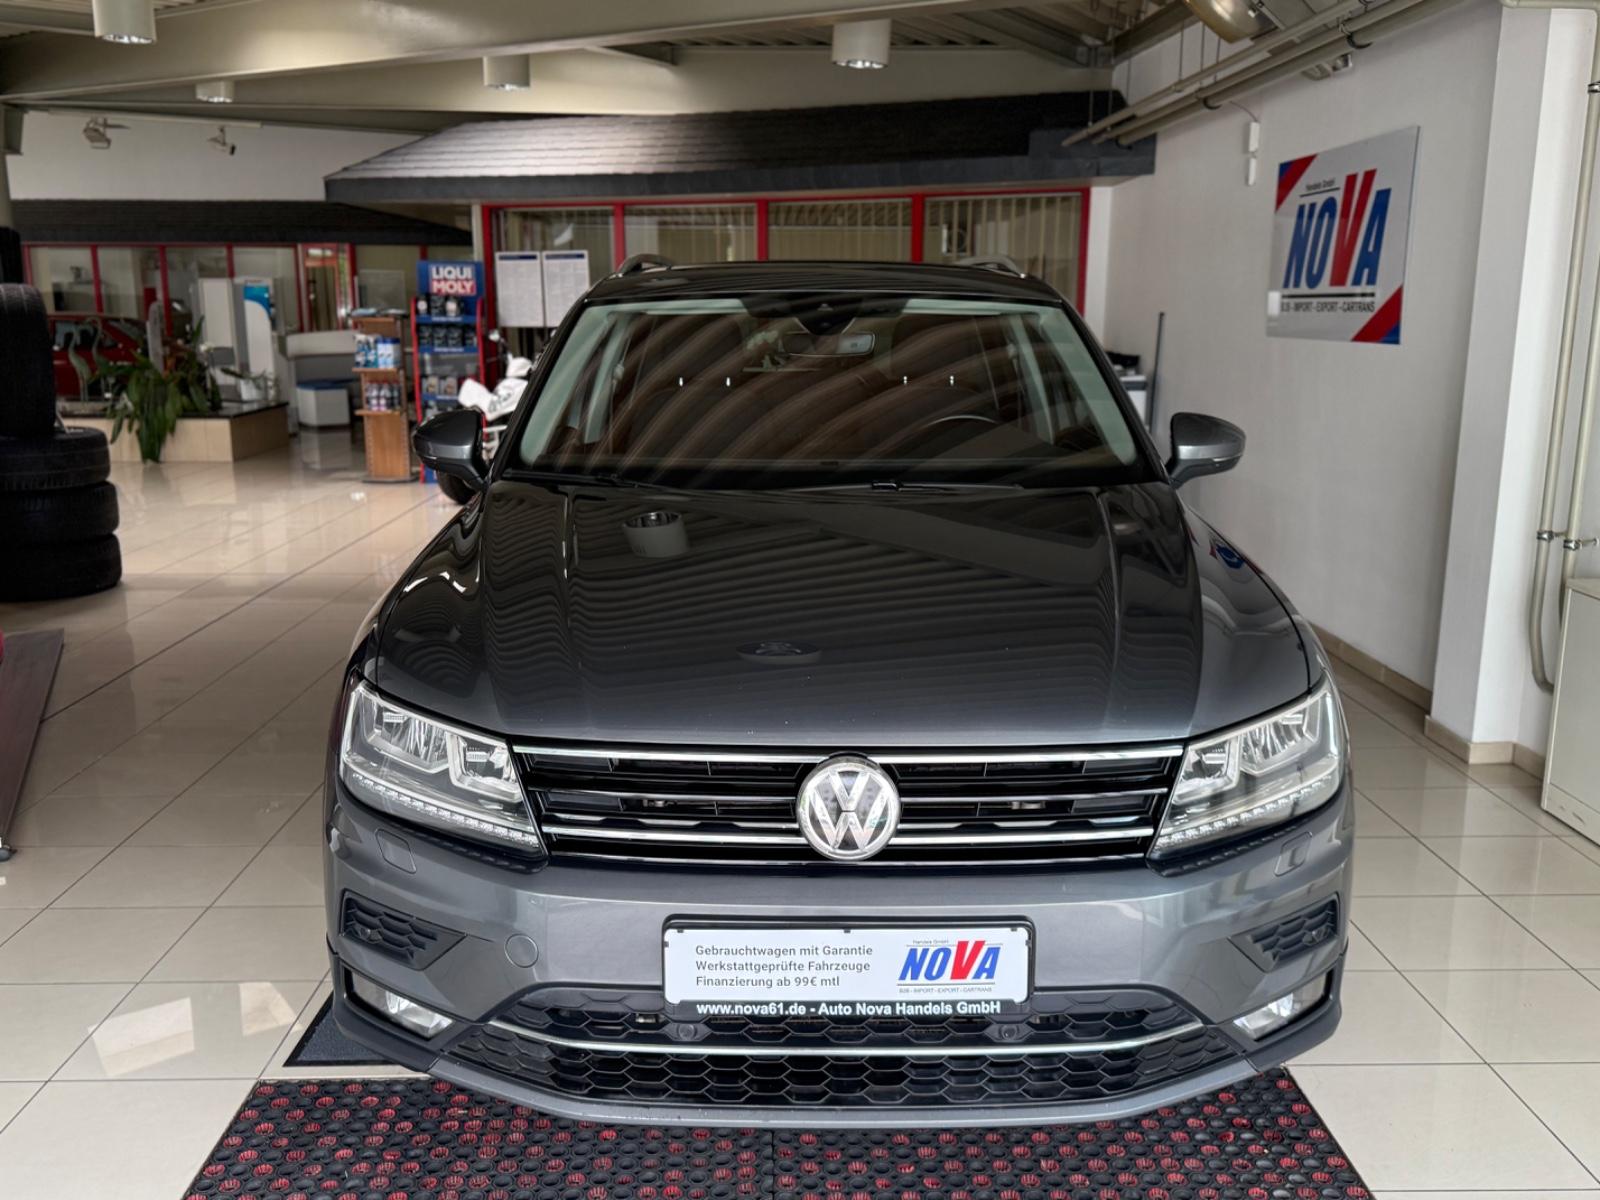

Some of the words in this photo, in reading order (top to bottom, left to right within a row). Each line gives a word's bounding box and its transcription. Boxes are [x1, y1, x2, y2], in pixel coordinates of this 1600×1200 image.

[1283, 168, 1392, 289] NOVA
[431, 266, 473, 279] LIQUI
[432, 280, 474, 294] MOLY
[695, 945, 796, 958] Gebrauchtwagen
[799, 945, 819, 956] mit
[822, 945, 873, 956] Garantie
[695, 960, 805, 973] Werkstattgeprüfte
[808, 960, 871, 973] Fahrzeuge
[898, 940, 1001, 981] NOVA
[696, 976, 773, 989] Finanzierung
[776, 976, 791, 987] ab
[795, 976, 817, 987] 99€
[820, 976, 840, 987] mtl
[696, 1003, 807, 1015] www.nova61.de
[818, 1003, 853, 1015] Auto
[856, 1003, 892, 1015] Nova
[895, 1002, 953, 1015] Handels
[957, 1001, 1001, 1014] GmbH
